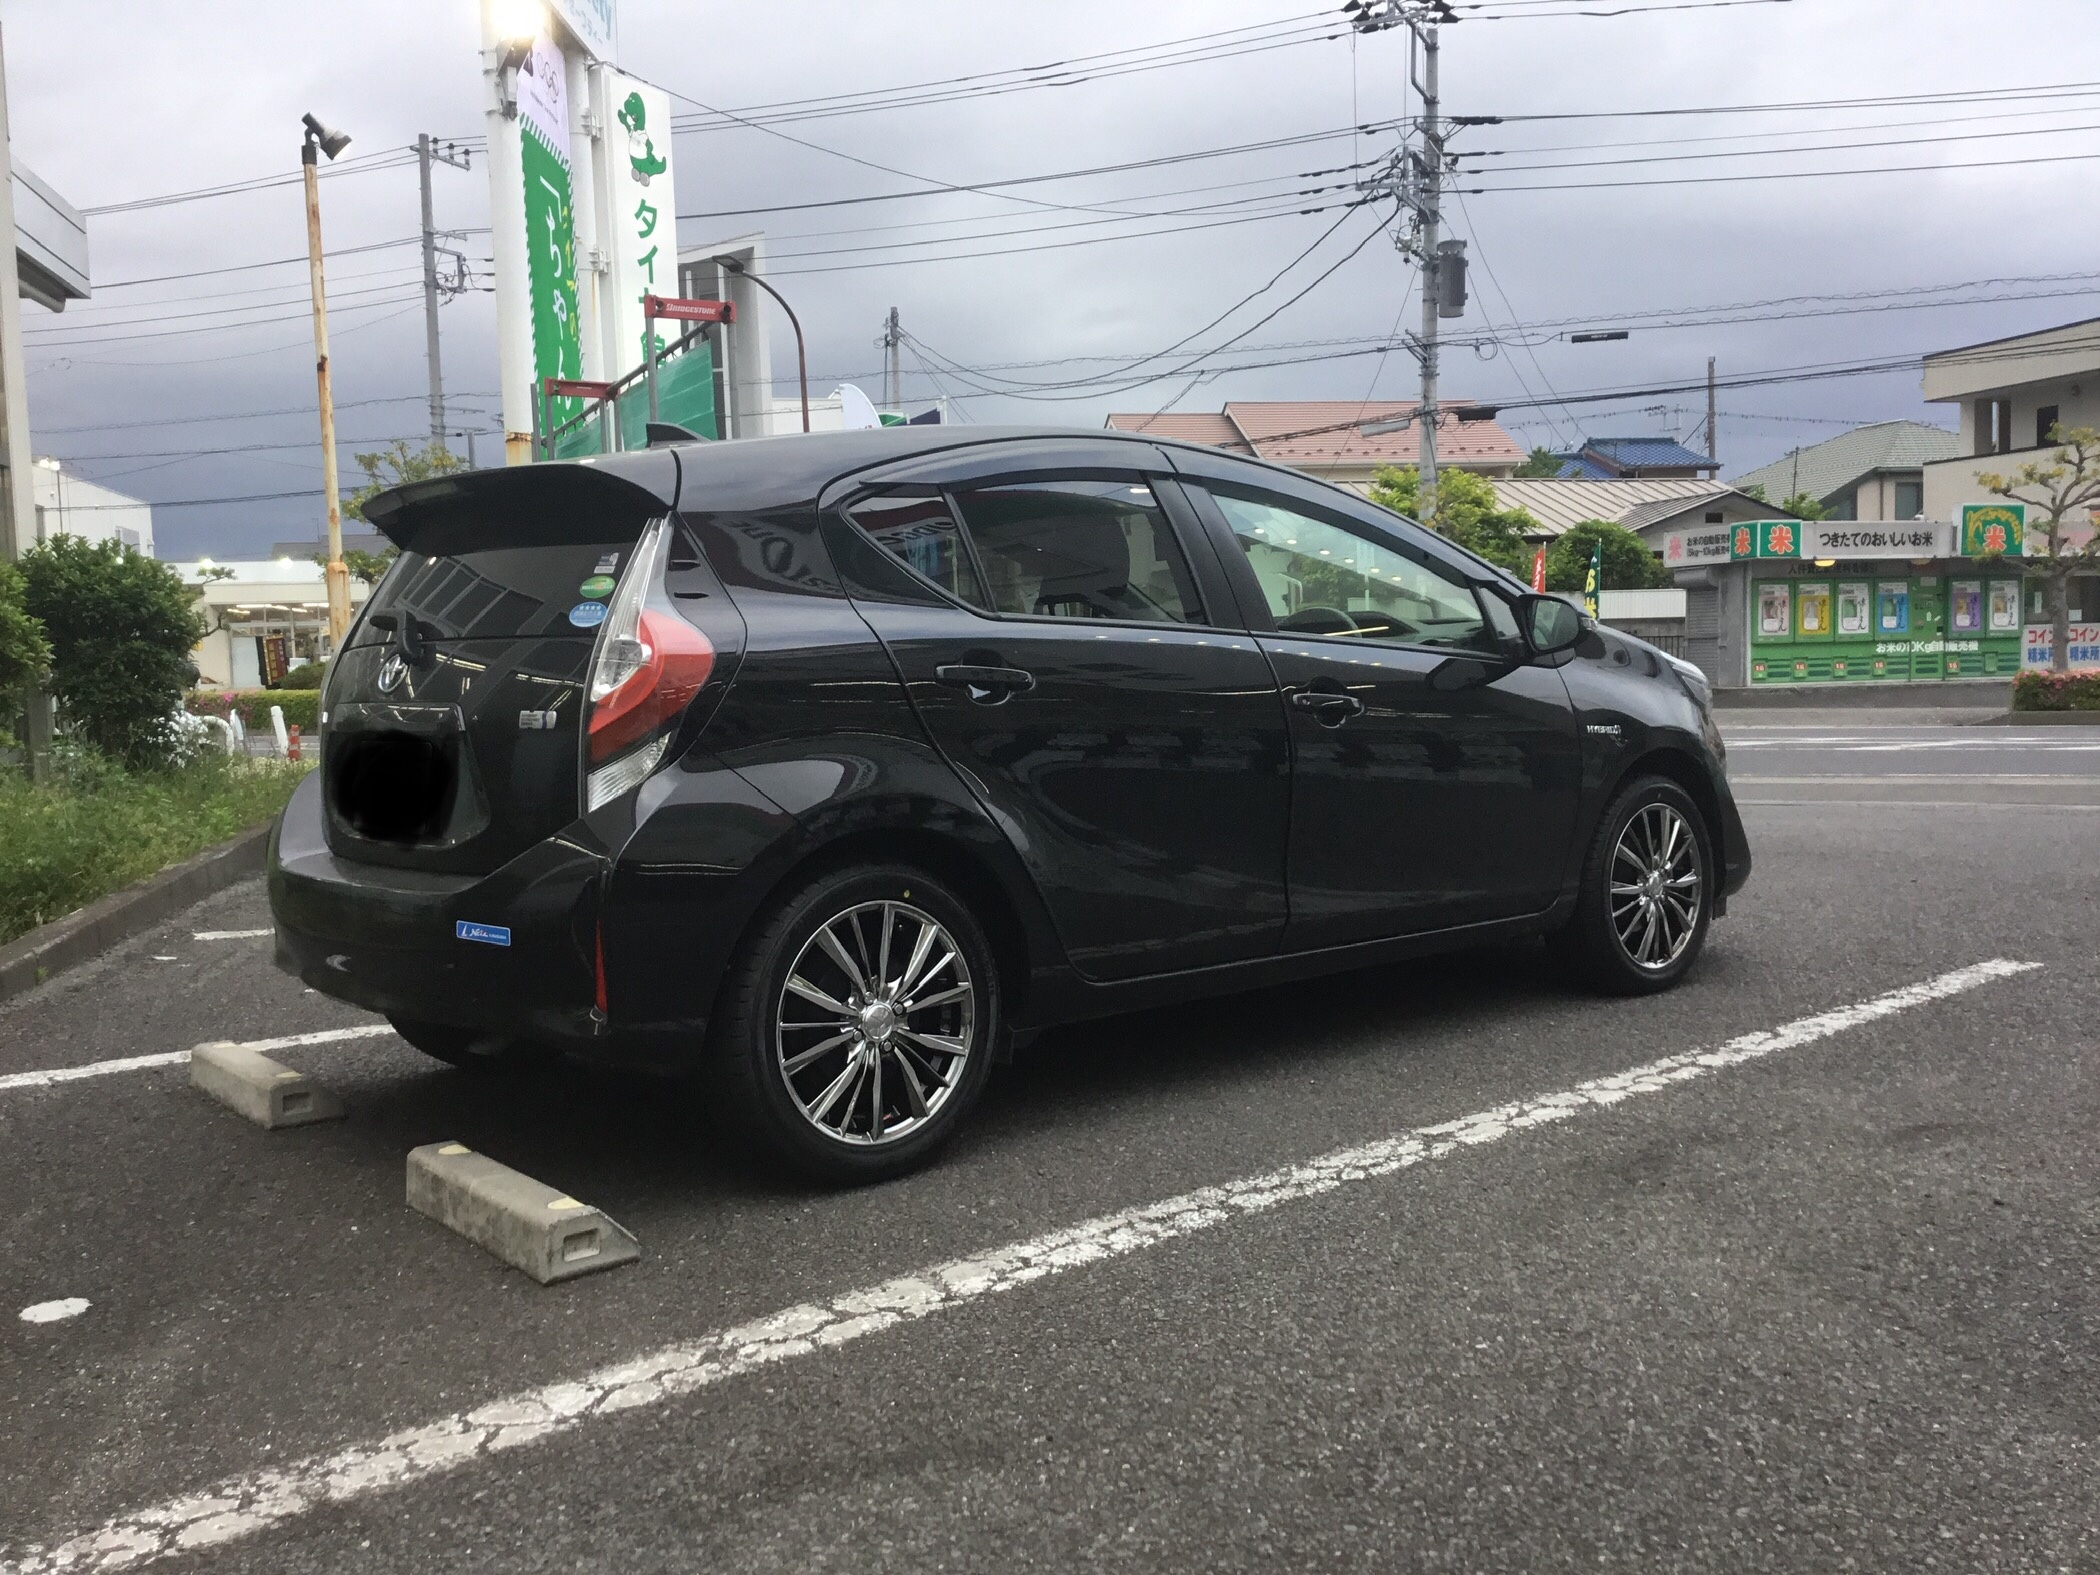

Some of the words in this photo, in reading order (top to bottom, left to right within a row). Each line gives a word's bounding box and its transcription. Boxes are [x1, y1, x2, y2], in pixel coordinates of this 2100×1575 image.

[666, 303, 716, 315] BRIDGESTONE
[1734, 527, 1751, 556] 米
[1768, 524, 1794, 555] 米
[1819, 532, 1933, 548] つきたてのおいしいお米
[1983, 523, 2006, 552] 米
[2070, 627, 2099, 642] コイン
